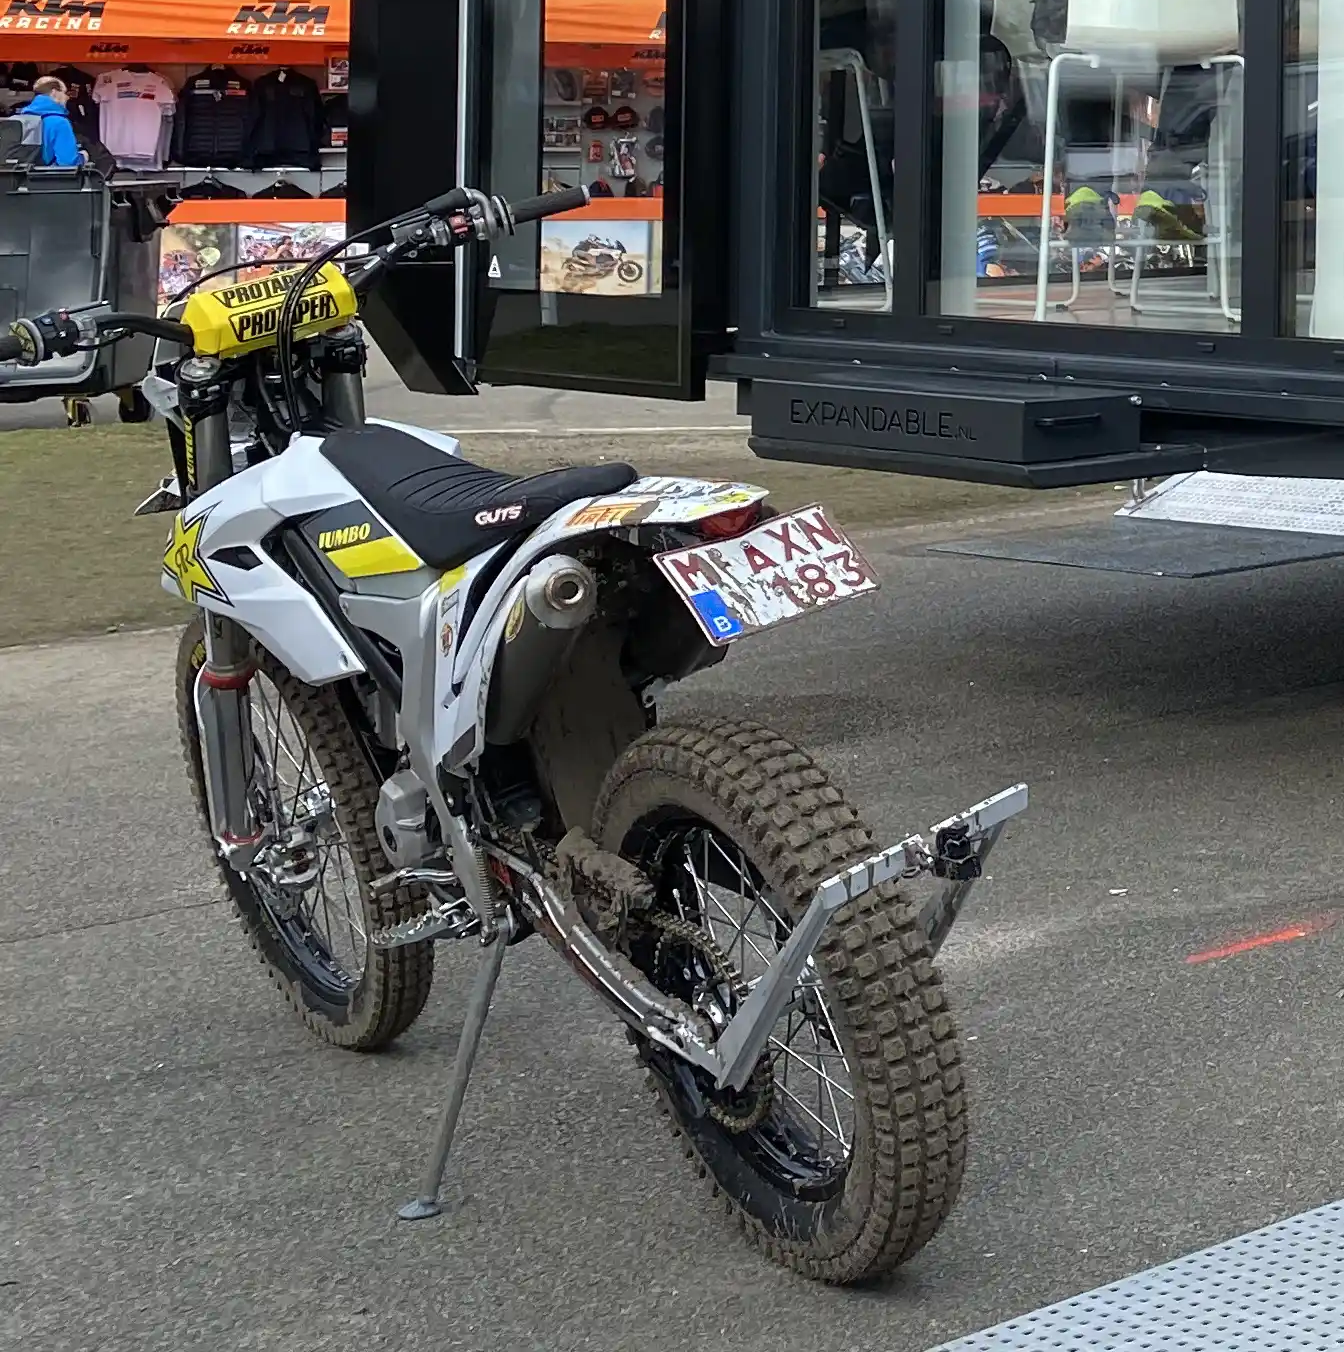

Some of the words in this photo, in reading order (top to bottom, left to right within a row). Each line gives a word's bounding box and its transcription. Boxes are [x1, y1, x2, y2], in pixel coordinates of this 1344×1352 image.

[233, 0, 330, 24] KTM
[222, 272, 318, 308] PROTAP
[789, 398, 978, 442] EXPANDABLE.NL
[474, 505, 523, 526] GUTS
[318, 522, 372, 549] JUMBO
[771, 548, 868, 608] 183
